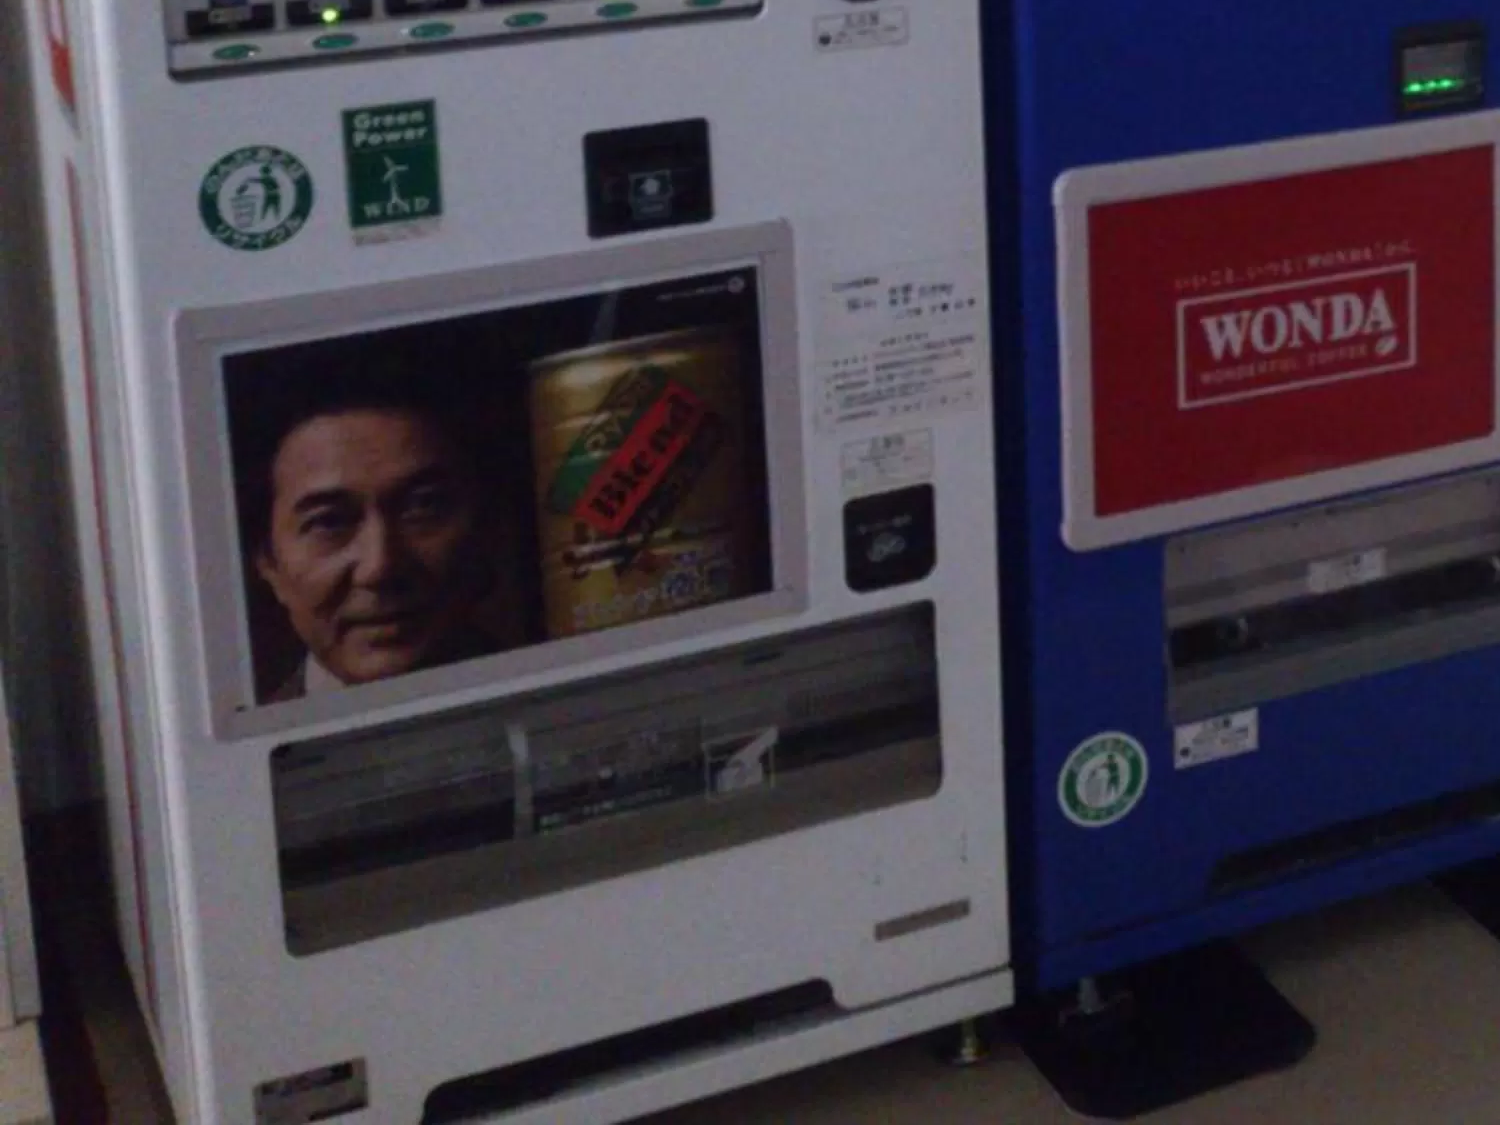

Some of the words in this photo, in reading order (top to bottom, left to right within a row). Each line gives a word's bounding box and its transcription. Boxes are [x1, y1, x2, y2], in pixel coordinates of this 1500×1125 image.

[353, 108, 425, 131] Green
[352, 126, 428, 148] Power
[364, 197, 430, 220] WIND
[1199, 287, 1397, 363] WONDA
